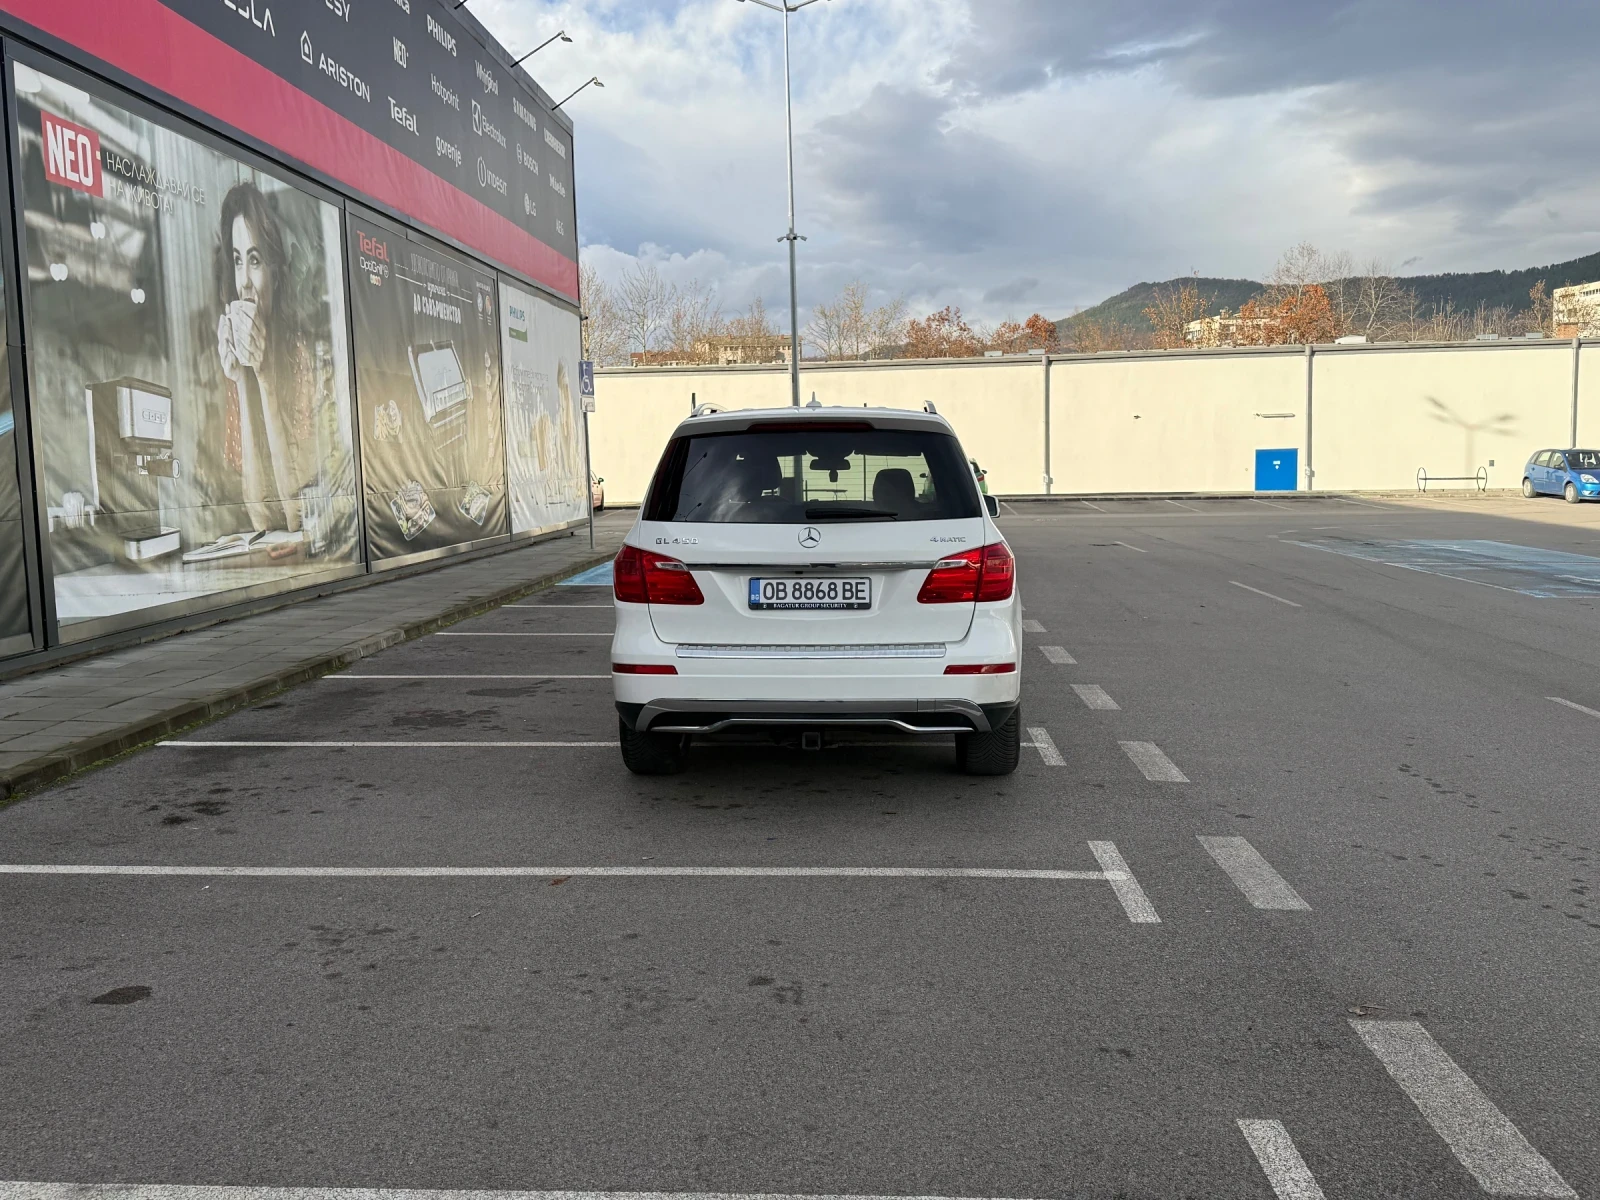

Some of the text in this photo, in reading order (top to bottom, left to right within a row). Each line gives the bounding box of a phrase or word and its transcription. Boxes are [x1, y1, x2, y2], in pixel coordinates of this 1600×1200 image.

[426, 14, 457, 57] PHILIPS
[318, 52, 371, 103] ARISTON
[430, 73, 460, 112] Hotpoint
[474, 59, 499, 96] Whirlpool
[387, 95, 419, 136] Tefal
[512, 97, 537, 132] SAMSUNG
[482, 115, 507, 148] Electrolux
[435, 135, 462, 168] gorenje
[523, 150, 539, 176] BOSCH
[109, 179, 125, 197] НА
[192, 186, 206, 205] СЕ
[549, 173, 566, 198] Miele
[555, 218, 565, 236] AEG
[356, 230, 390, 263] Tefal
[509, 305, 526, 322] PHILIPS
[655, 537, 670, 545] GL
[763, 581, 867, 601] OB 8868 BE
